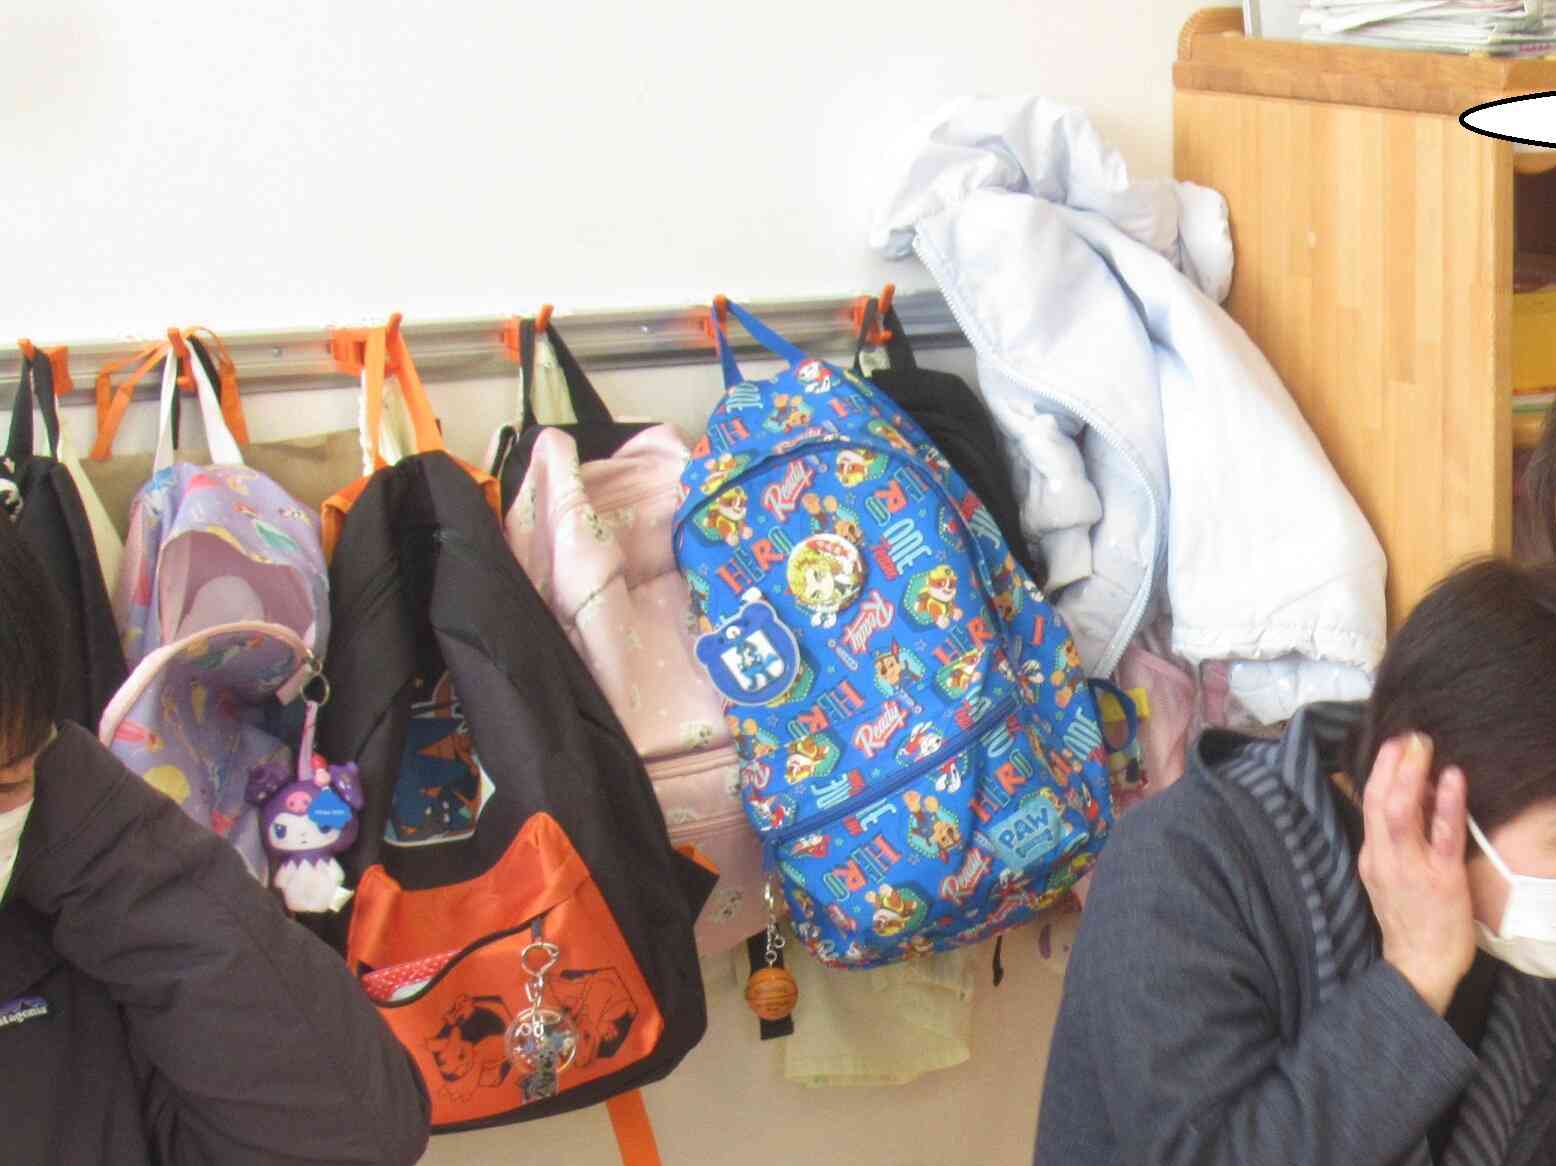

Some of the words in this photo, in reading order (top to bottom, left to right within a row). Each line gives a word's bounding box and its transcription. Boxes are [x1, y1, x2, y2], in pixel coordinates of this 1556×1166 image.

[716, 526, 794, 593] HERO
[854, 700, 908, 758] Ready
[998, 807, 1049, 846] PAW
[823, 834, 902, 901] HERO
